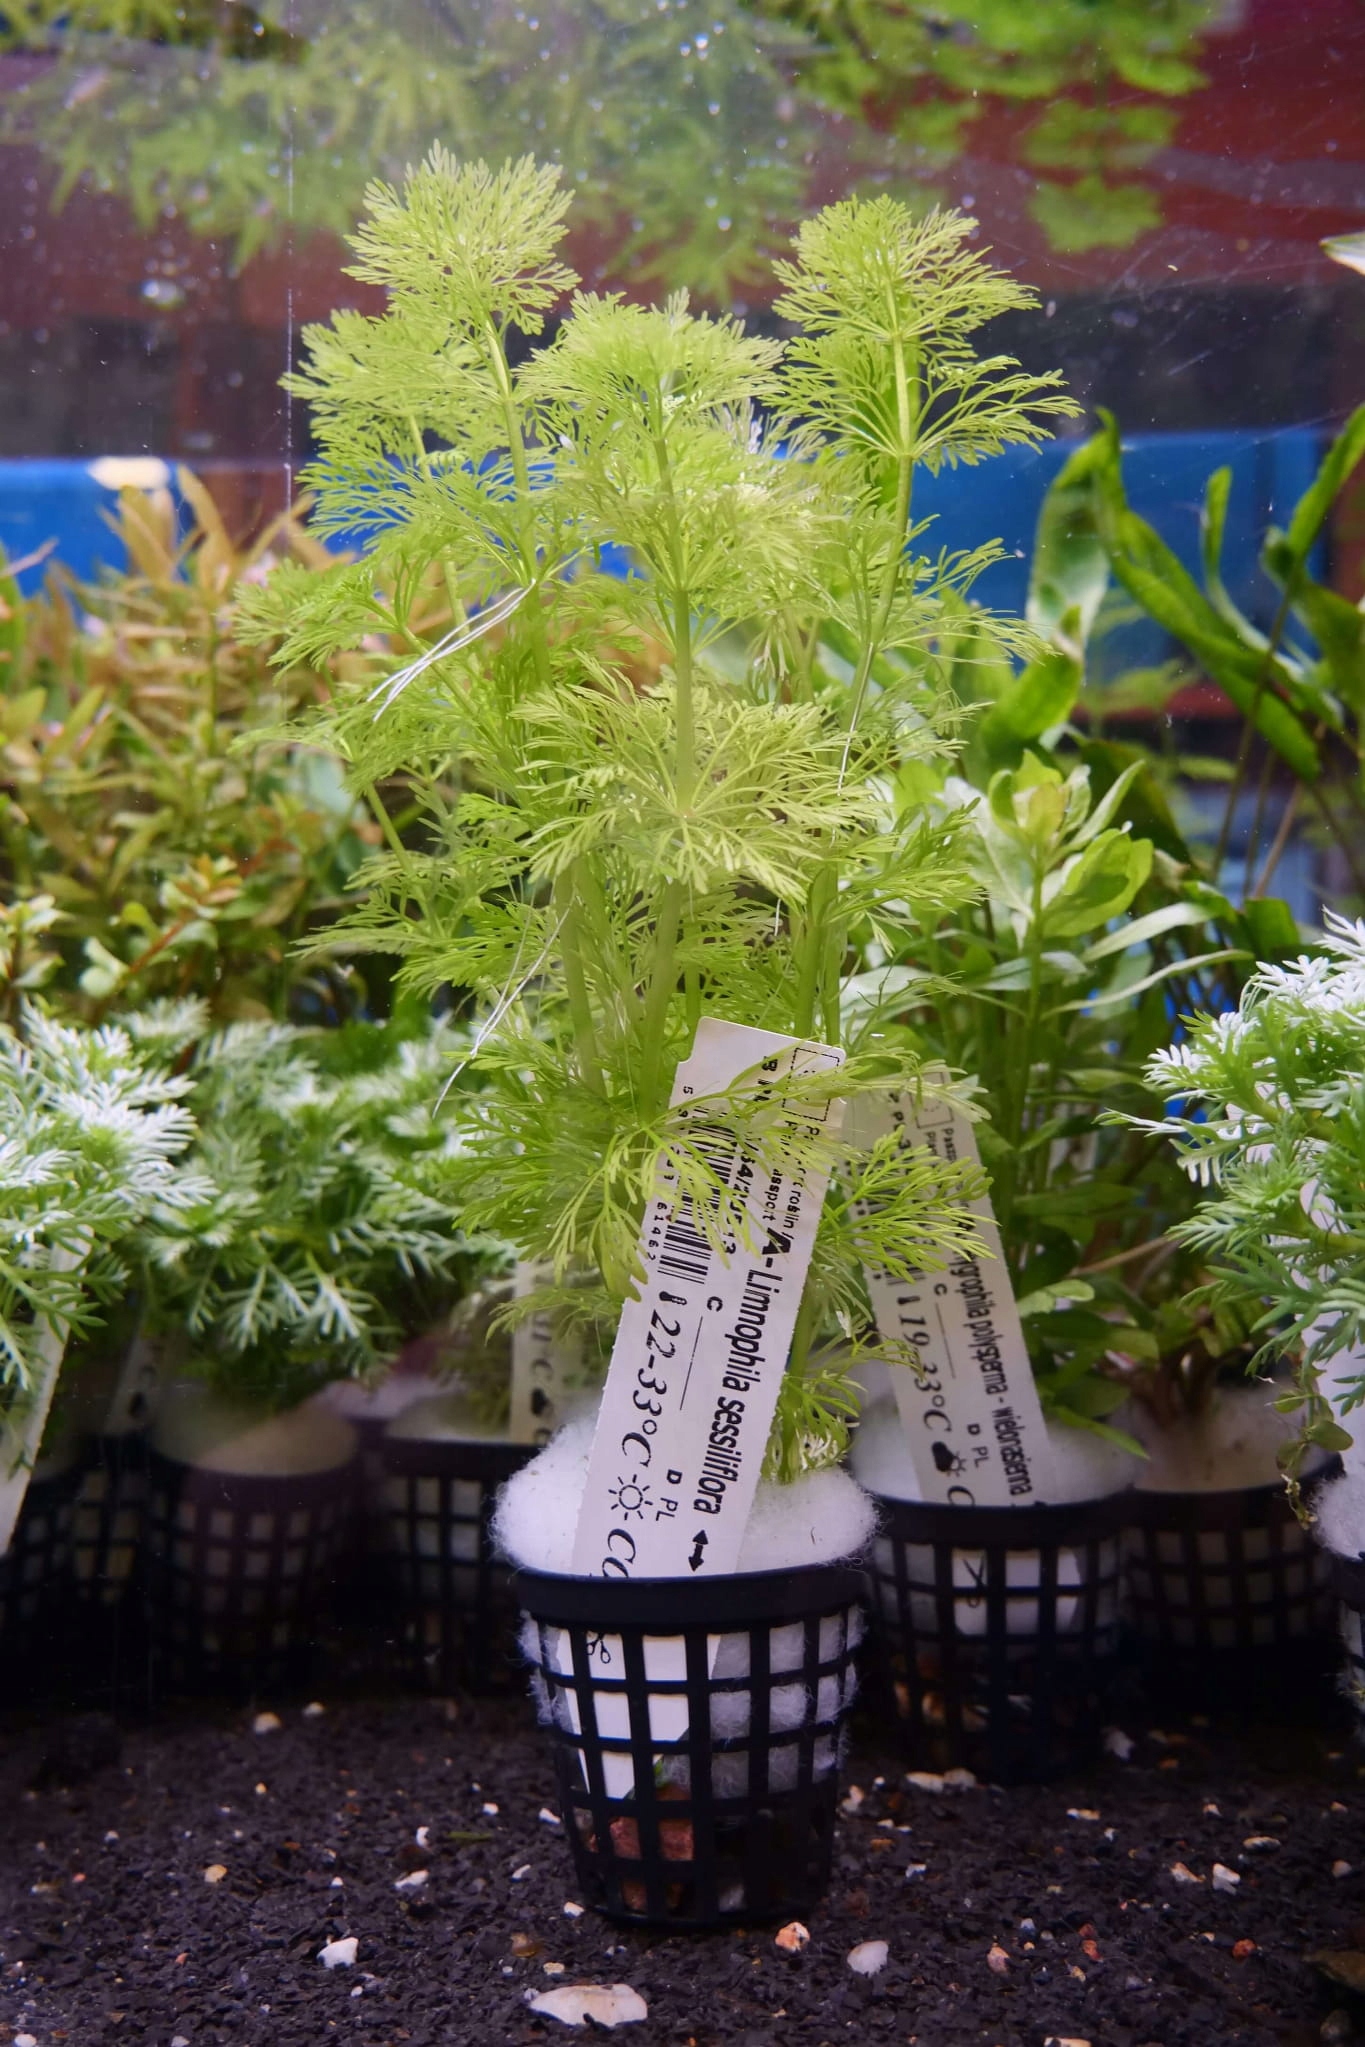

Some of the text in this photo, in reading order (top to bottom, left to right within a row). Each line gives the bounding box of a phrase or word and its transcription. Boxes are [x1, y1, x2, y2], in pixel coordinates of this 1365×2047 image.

[706, 1296, 723, 1311] C
[722, 1269, 782, 1391] Limnophila
[621, 1309, 680, 1467] 22-33°C
[655, 1469, 682, 1521] D PL
[693, 1396, 745, 1514] sessiliflora
[972, 1446, 988, 1467] PL
